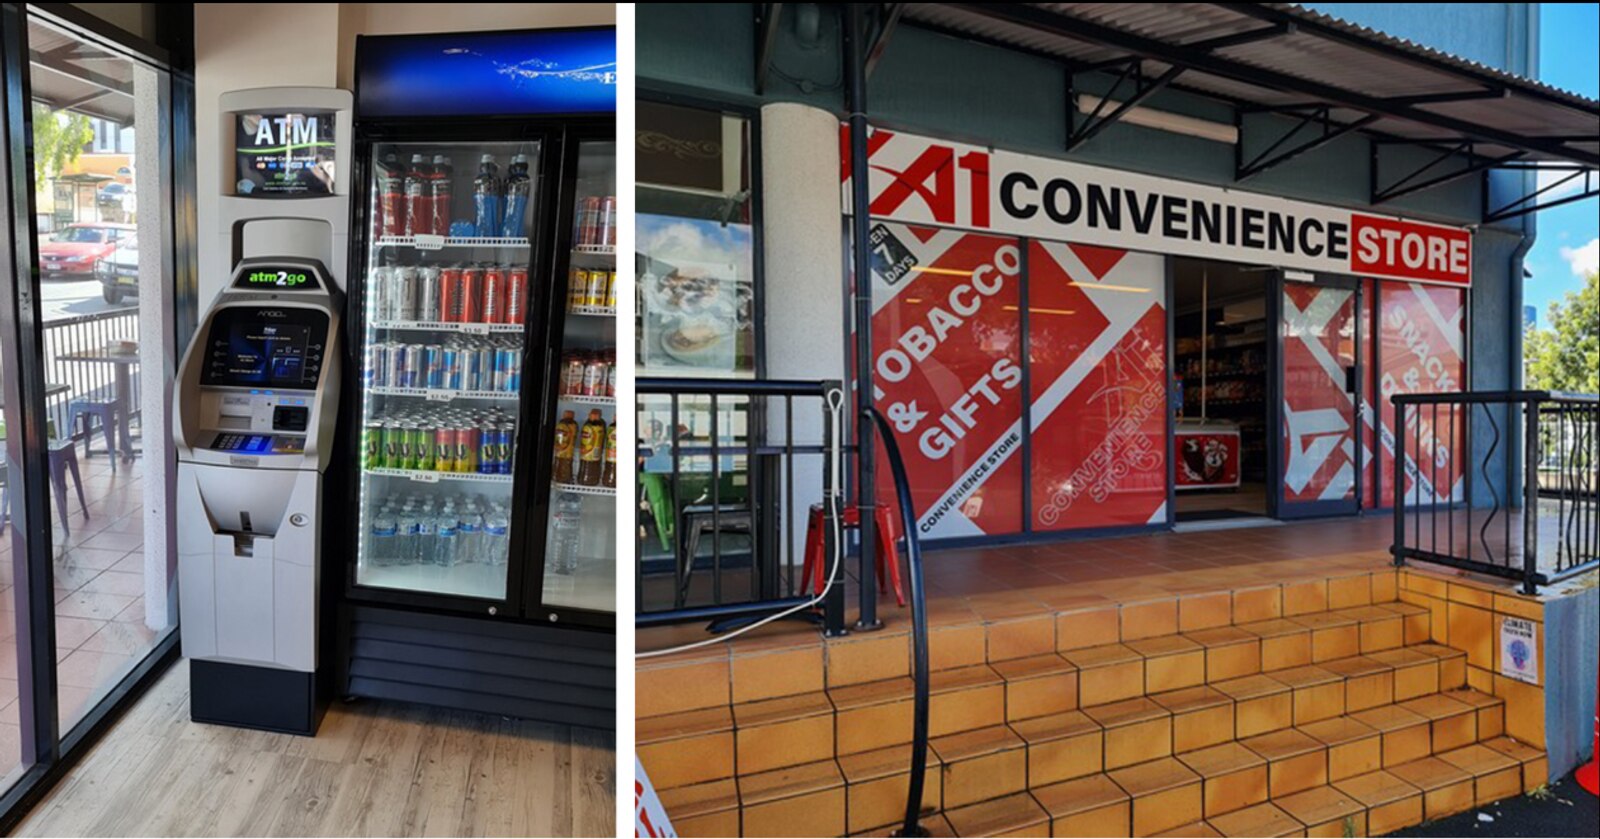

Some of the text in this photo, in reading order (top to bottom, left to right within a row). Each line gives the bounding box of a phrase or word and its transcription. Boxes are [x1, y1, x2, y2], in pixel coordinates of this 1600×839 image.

[254, 117, 318, 146] ATM
[873, 242, 894, 265] 7
[999, 171, 1350, 260] CONVENIENCE
[1357, 225, 1469, 275] STORE
[249, 271, 306, 286] atm2go
[885, 255, 915, 283] DAYS
[873, 244, 1021, 401] OBACCO
[1388, 304, 1461, 396] SNACK
[887, 399, 929, 433] &
[918, 358, 1022, 460] GIFTS
[920, 432, 1020, 533] CONVENIENCE STORE
[1038, 380, 1167, 526] CONVENIENCE
[1088, 431, 1153, 503] STORE
